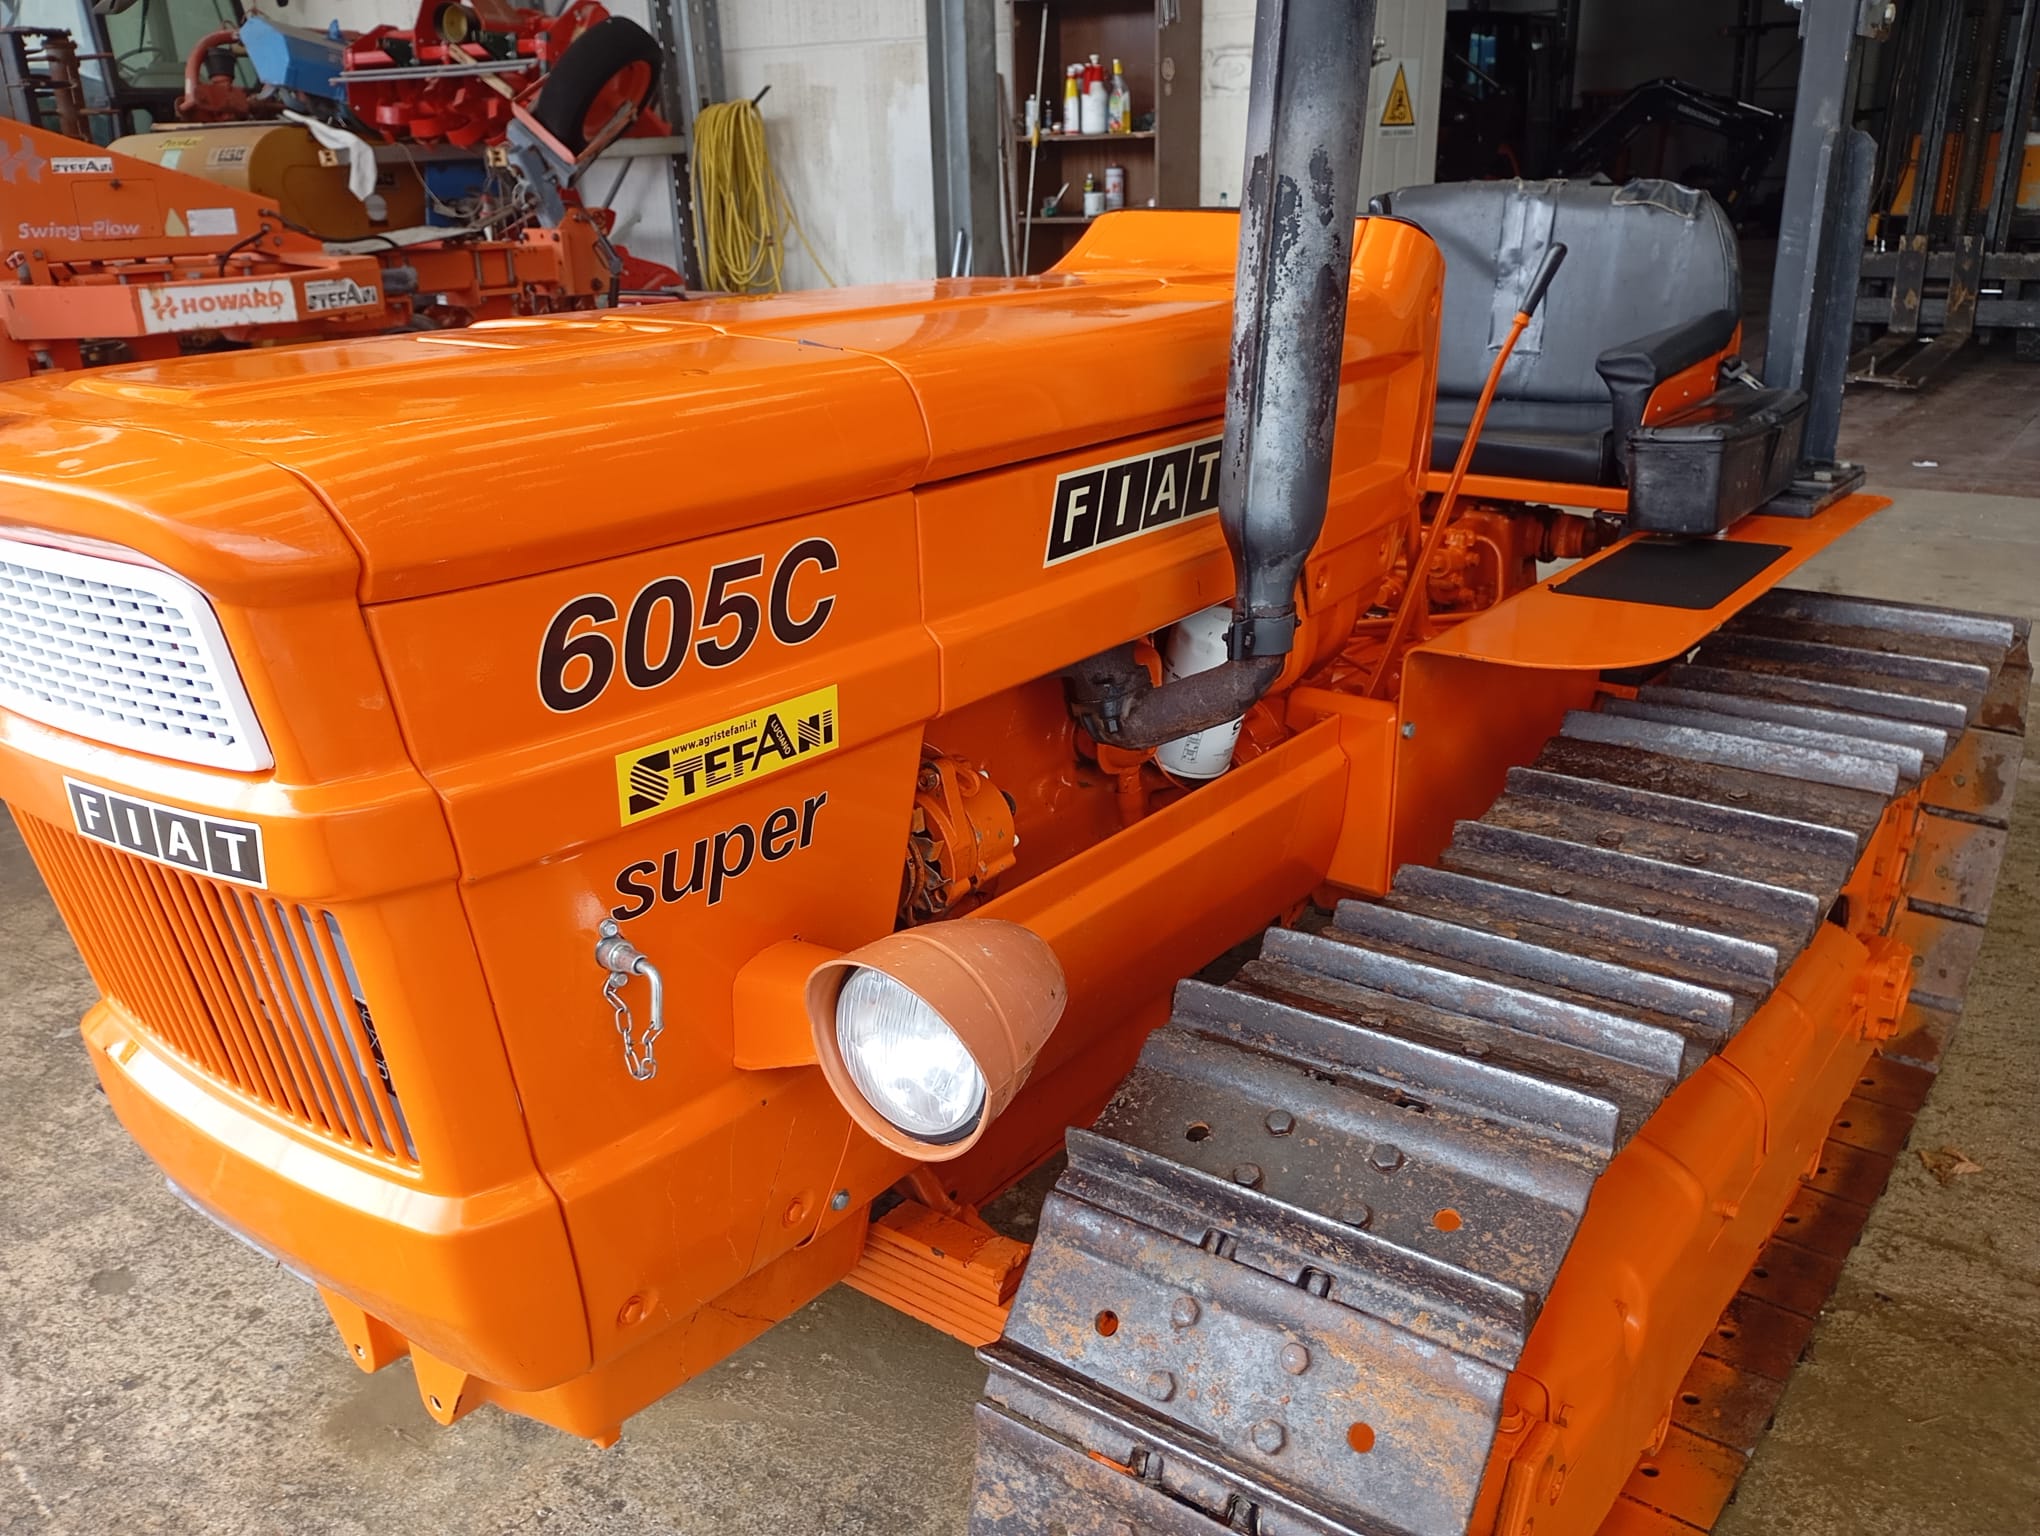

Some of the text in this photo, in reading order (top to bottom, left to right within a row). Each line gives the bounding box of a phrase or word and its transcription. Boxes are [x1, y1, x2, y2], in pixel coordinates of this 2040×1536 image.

[182, 291, 284, 315] HOWARD
[1063, 450, 1221, 544] FIAT
[536, 536, 839, 714] 605C
[628, 712, 833, 816] STEFANI
[671, 719, 757, 756] www.agristefani.it
[770, 719, 791, 755] LUCIANO
[78, 792, 248, 873] FIAT
[610, 790, 829, 922] super
